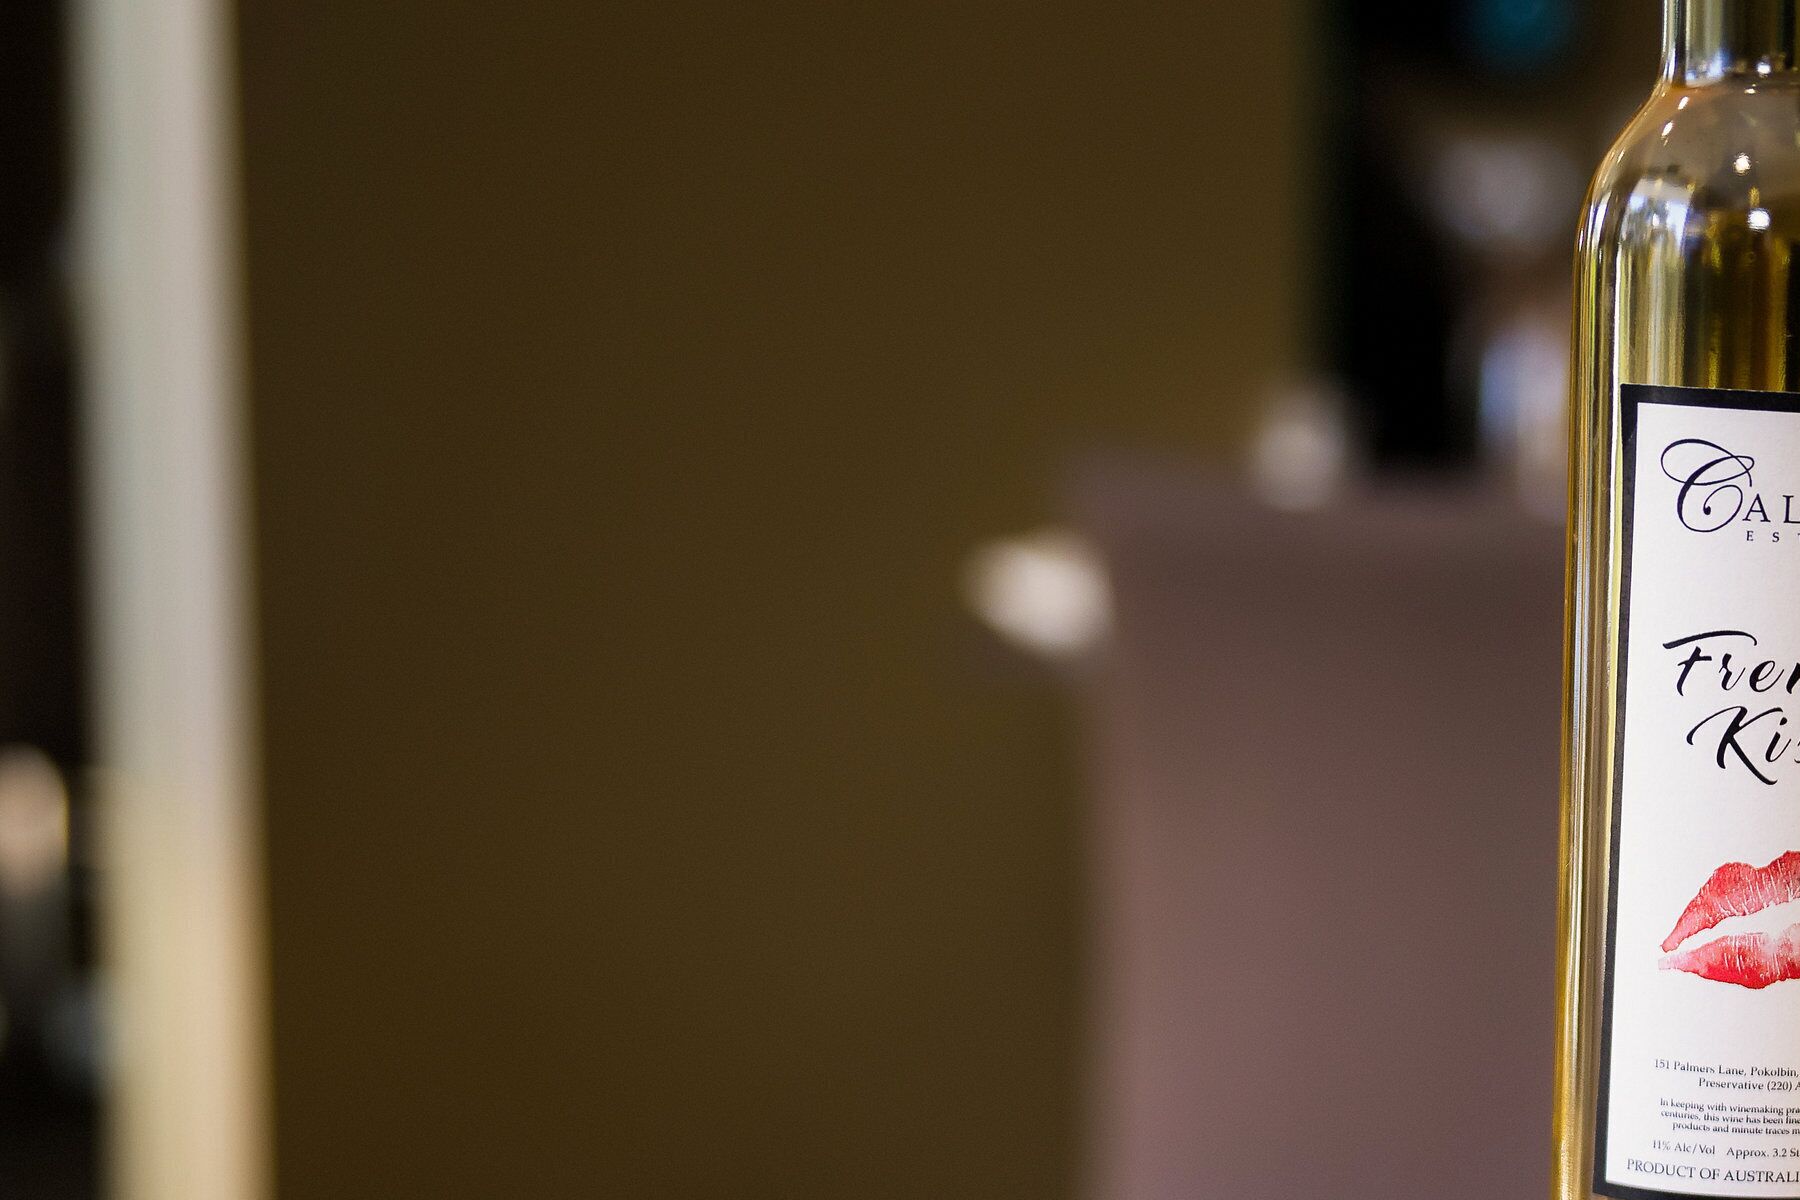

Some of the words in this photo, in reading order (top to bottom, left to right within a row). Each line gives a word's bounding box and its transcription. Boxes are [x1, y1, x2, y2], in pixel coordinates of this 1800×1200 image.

[1654, 1059, 1670, 1070] 151
[1673, 1060, 1716, 1074] Palmers
[1718, 1064, 1747, 1076] Lane,
[1750, 1066, 1799, 1078] Pokolbin,
[1698, 1077, 1764, 1090] Preservative
[1766, 1081, 1793, 1092] (220)
[1660, 1098, 1669, 1106] In
[1670, 1098, 1705, 1112] keeping
[1706, 1102, 1727, 1112] with
[1729, 1104, 1784, 1116] winemaking
[1660, 1110, 1701, 1121] centuries,
[1703, 1113, 1720, 1122] this
[1745, 1114, 1761, 1124] has
[1762, 1116, 1784, 1124] been
[1672, 1121, 1711, 1131] products
[1712, 1124, 1729, 1133] and
[1731, 1126, 1763, 1135] minute
[1765, 1127, 1790, 1135] traces
[1653, 1139, 1671, 1151] 11%
[1674, 1142, 1716, 1154] Alc/Vol
[1726, 1146, 1770, 1159] Approx.
[1772, 1148, 1787, 1157] 3.2
[1627, 1158, 1696, 1178] PRODUCT
[1699, 1167, 1720, 1180] OF
